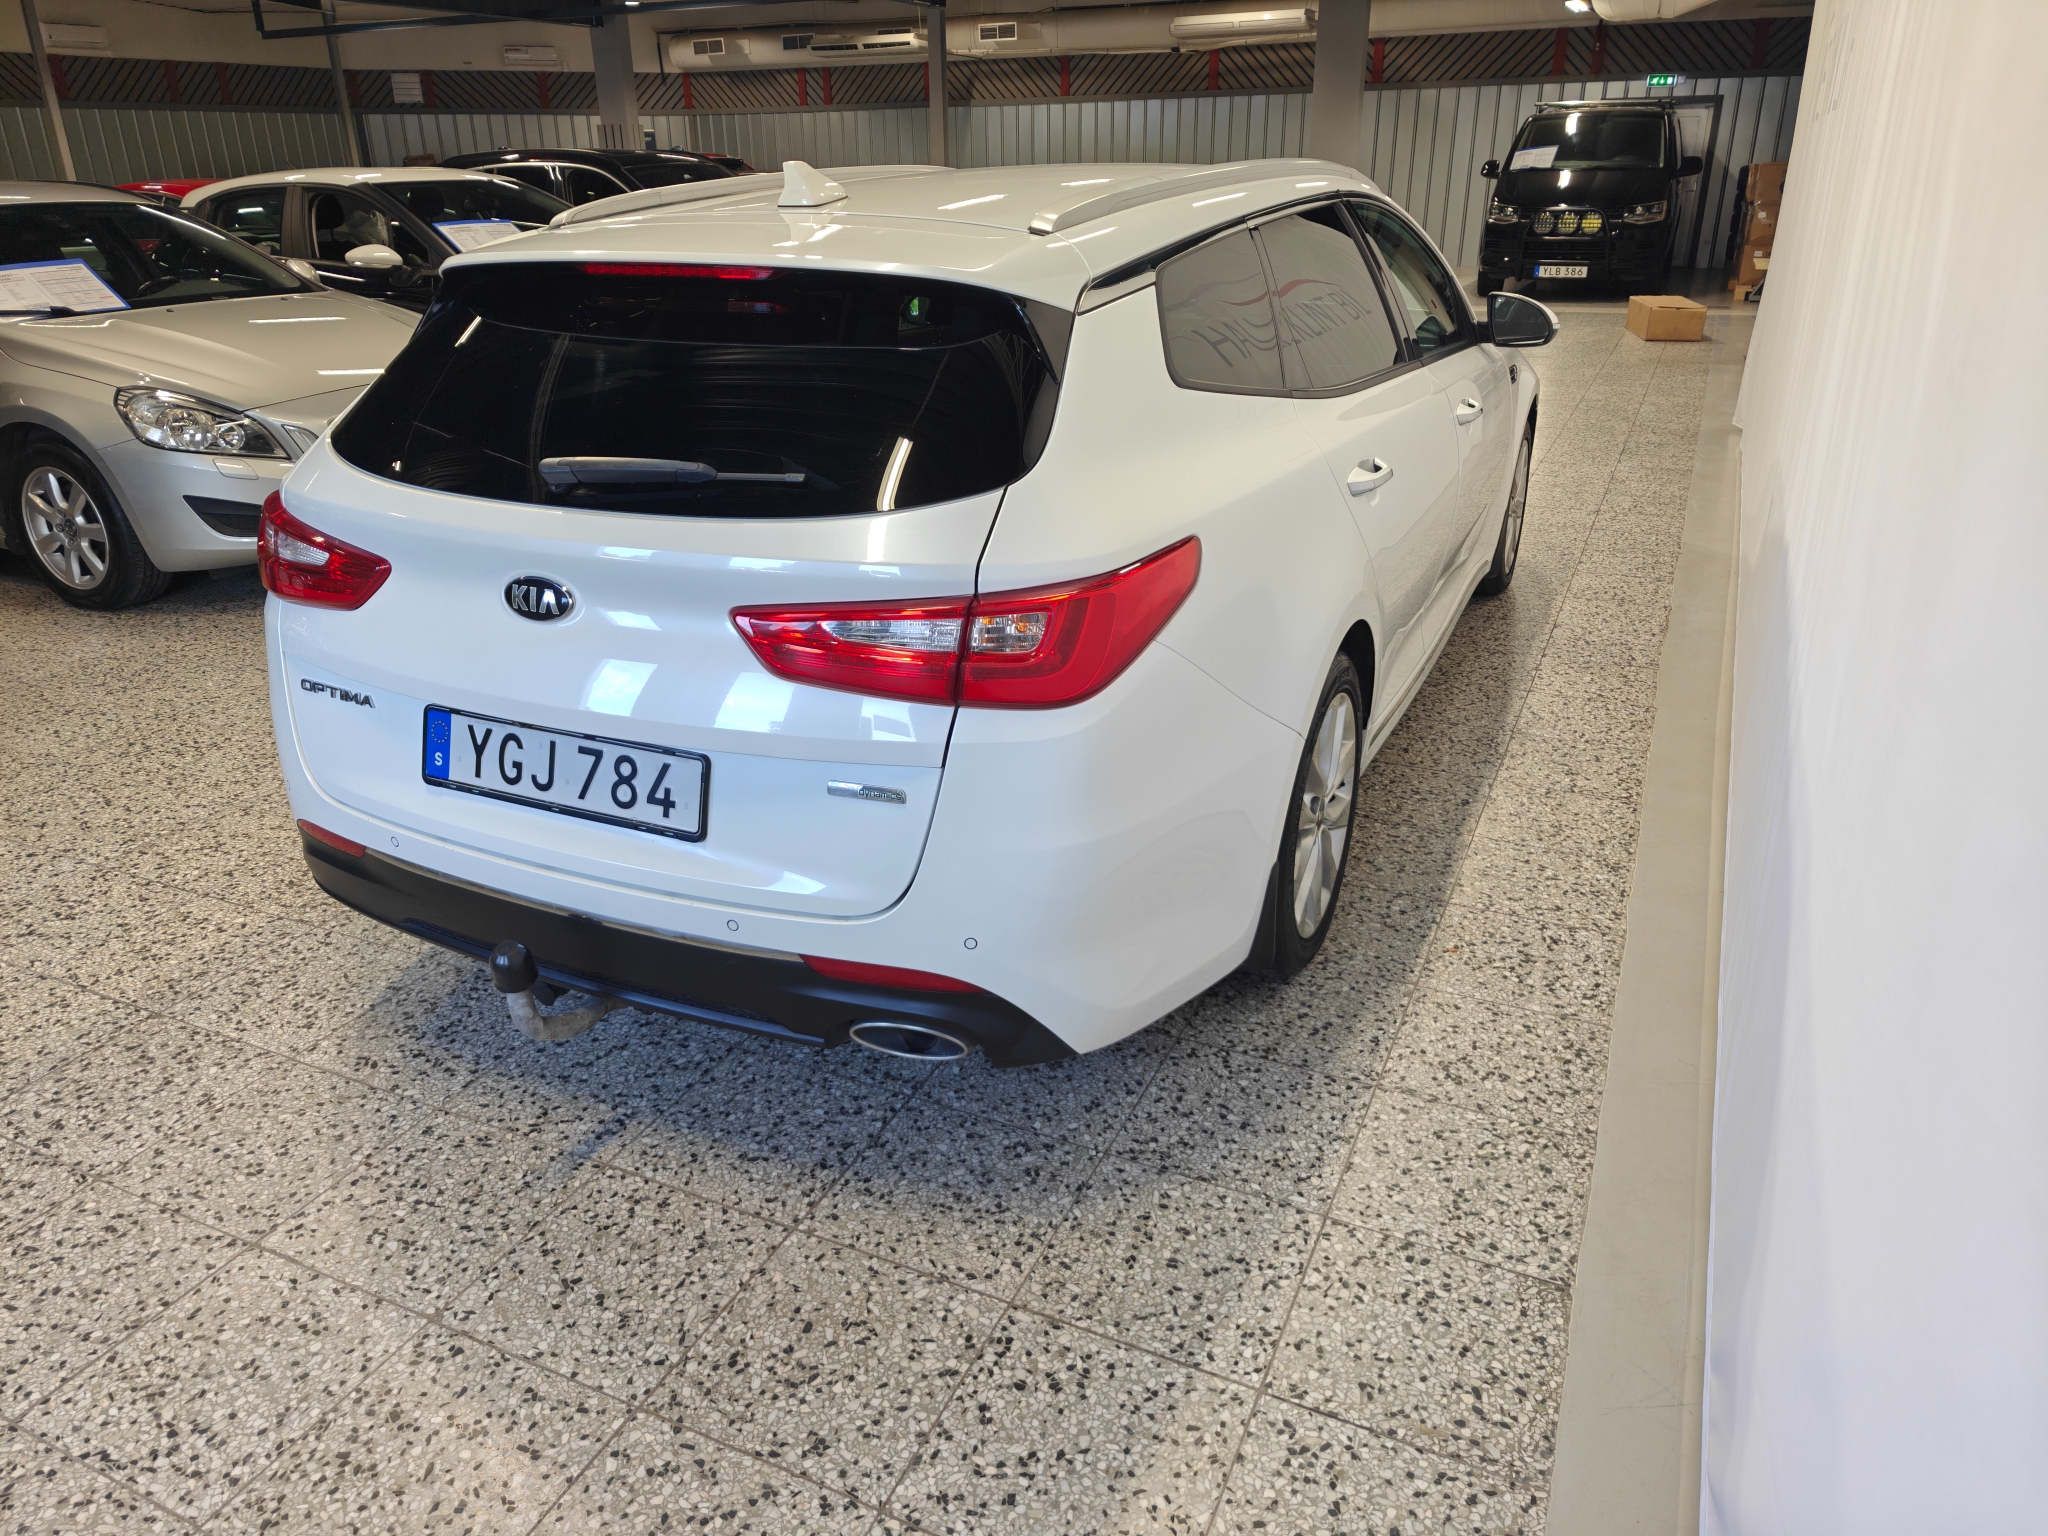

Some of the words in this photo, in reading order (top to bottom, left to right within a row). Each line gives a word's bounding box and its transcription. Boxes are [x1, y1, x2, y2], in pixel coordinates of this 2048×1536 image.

[1543, 267, 1561, 276] YLB
[1564, 267, 1583, 276] 386
[511, 583, 560, 615] KIA
[301, 678, 376, 709] OPTIMA
[434, 752, 443, 767] S
[467, 724, 557, 792] YGJ
[577, 745, 677, 819] 784
